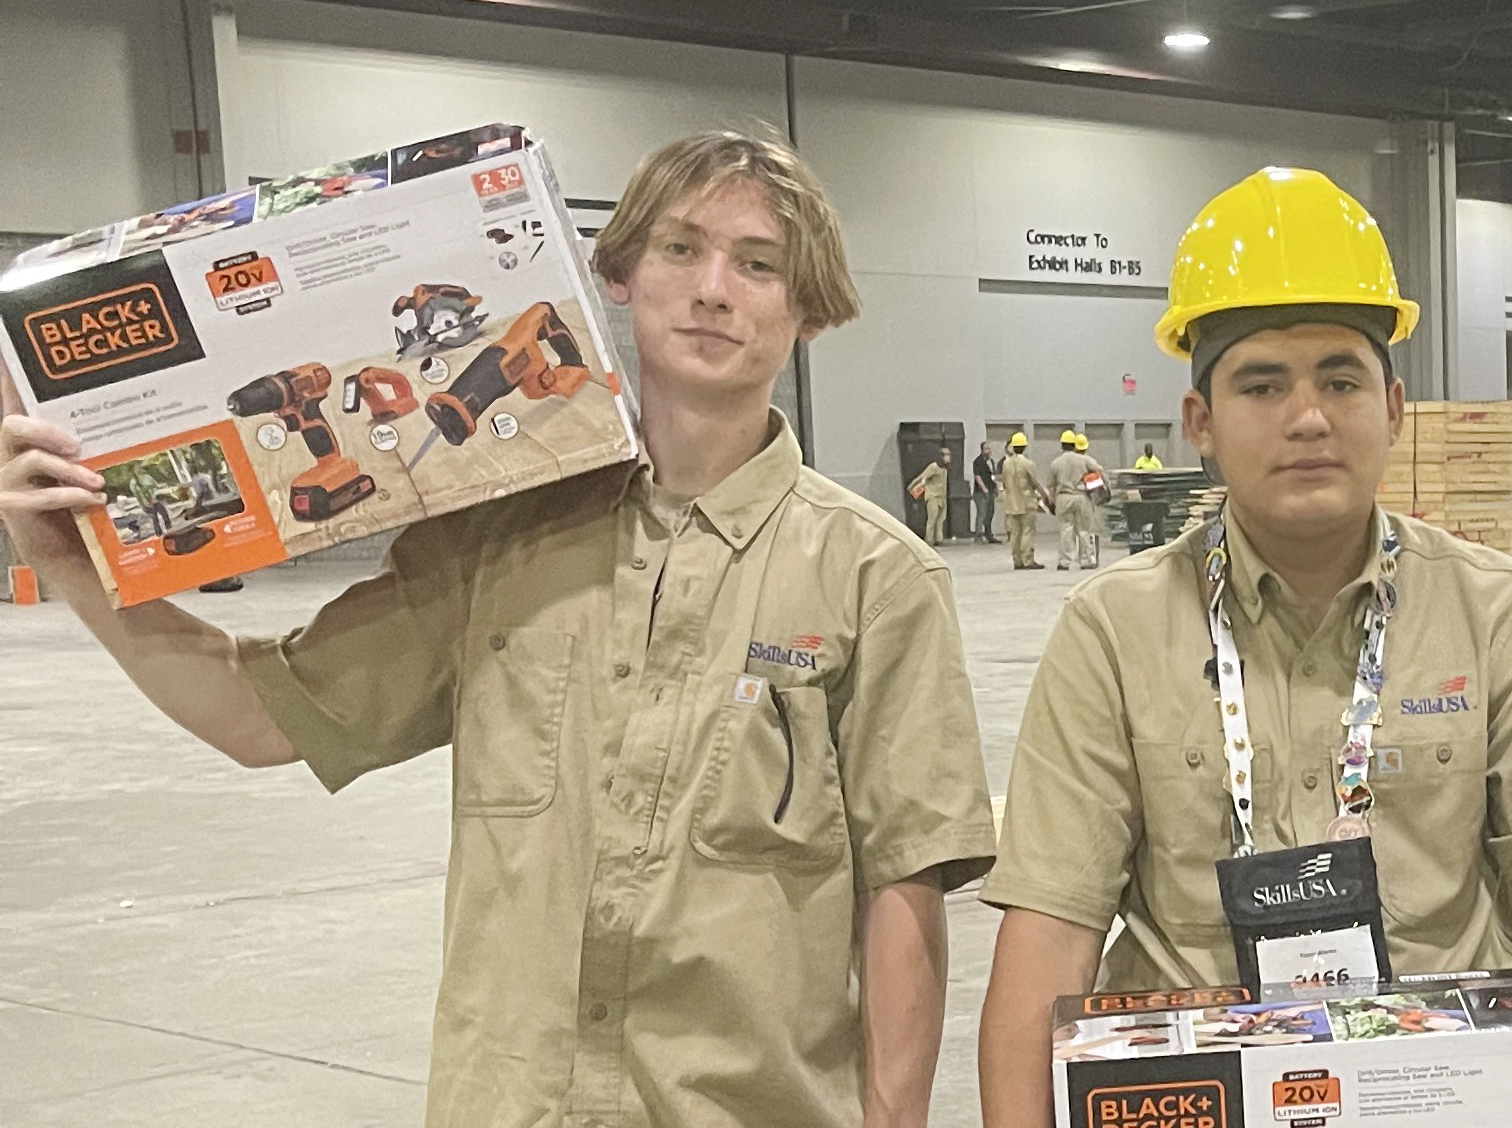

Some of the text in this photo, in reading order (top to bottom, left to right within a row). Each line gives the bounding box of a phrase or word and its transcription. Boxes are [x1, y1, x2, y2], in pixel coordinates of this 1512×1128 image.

[480, 167, 520, 189] 2 30
[1027, 229, 1109, 248] Connector To
[1029, 254, 1141, 276] Exhibit Halls B1-B5
[40, 300, 152, 344] BLACK+
[50, 319, 165, 367] DECKER
[749, 641, 817, 671] SkillsUSA
[1400, 695, 1470, 715] SkillsUSA
[1253, 878, 1338, 907] SkillsUSA
[1288, 1072, 1323, 1080] BATTERY
[1100, 1094, 1213, 1121] BLACK+
[1278, 1107, 1319, 1117] LITHIUM
